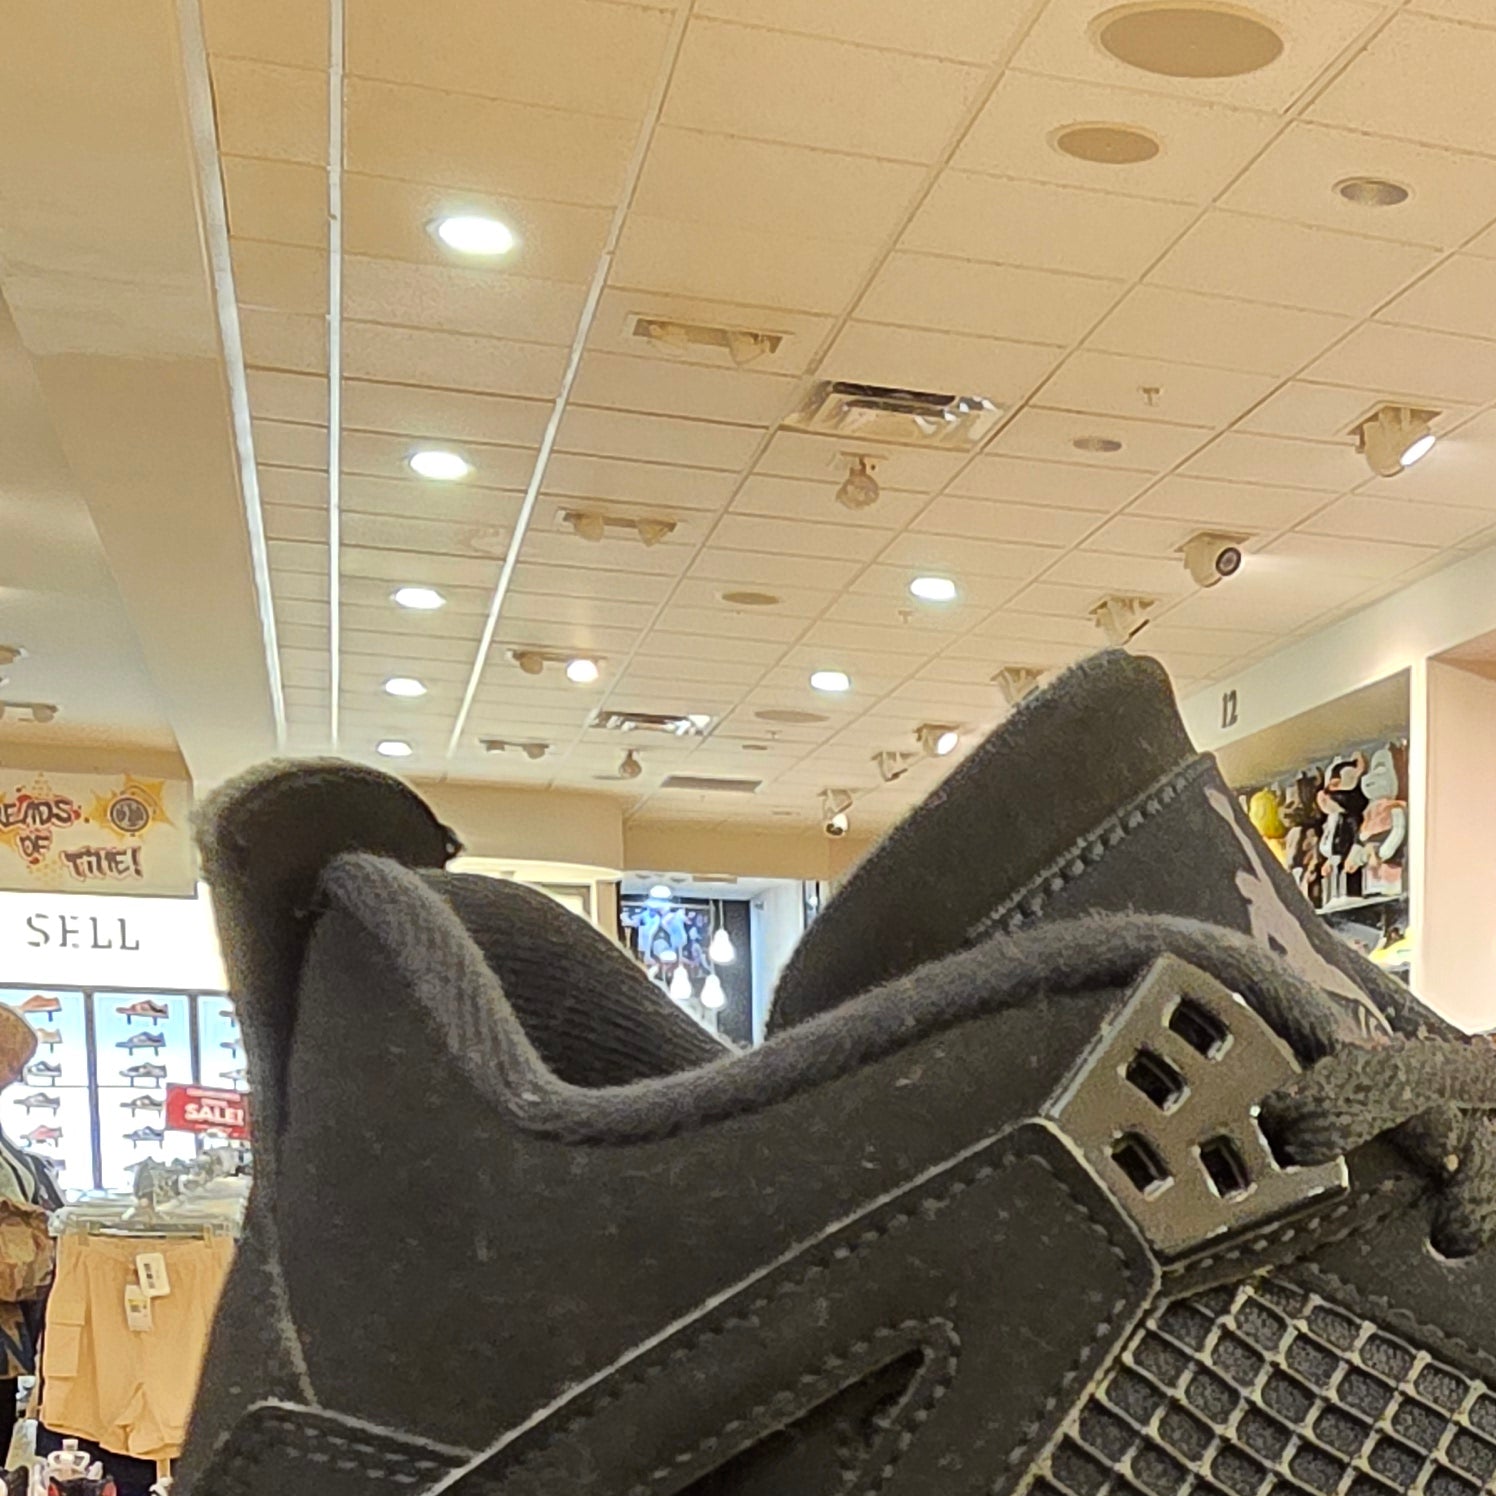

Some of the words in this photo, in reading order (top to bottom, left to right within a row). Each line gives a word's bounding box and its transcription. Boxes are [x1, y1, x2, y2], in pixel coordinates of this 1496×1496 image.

[1221, 689, 1238, 728] 12
[27, 913, 139, 950] SELL
[184, 1102, 244, 1126] SALE!
